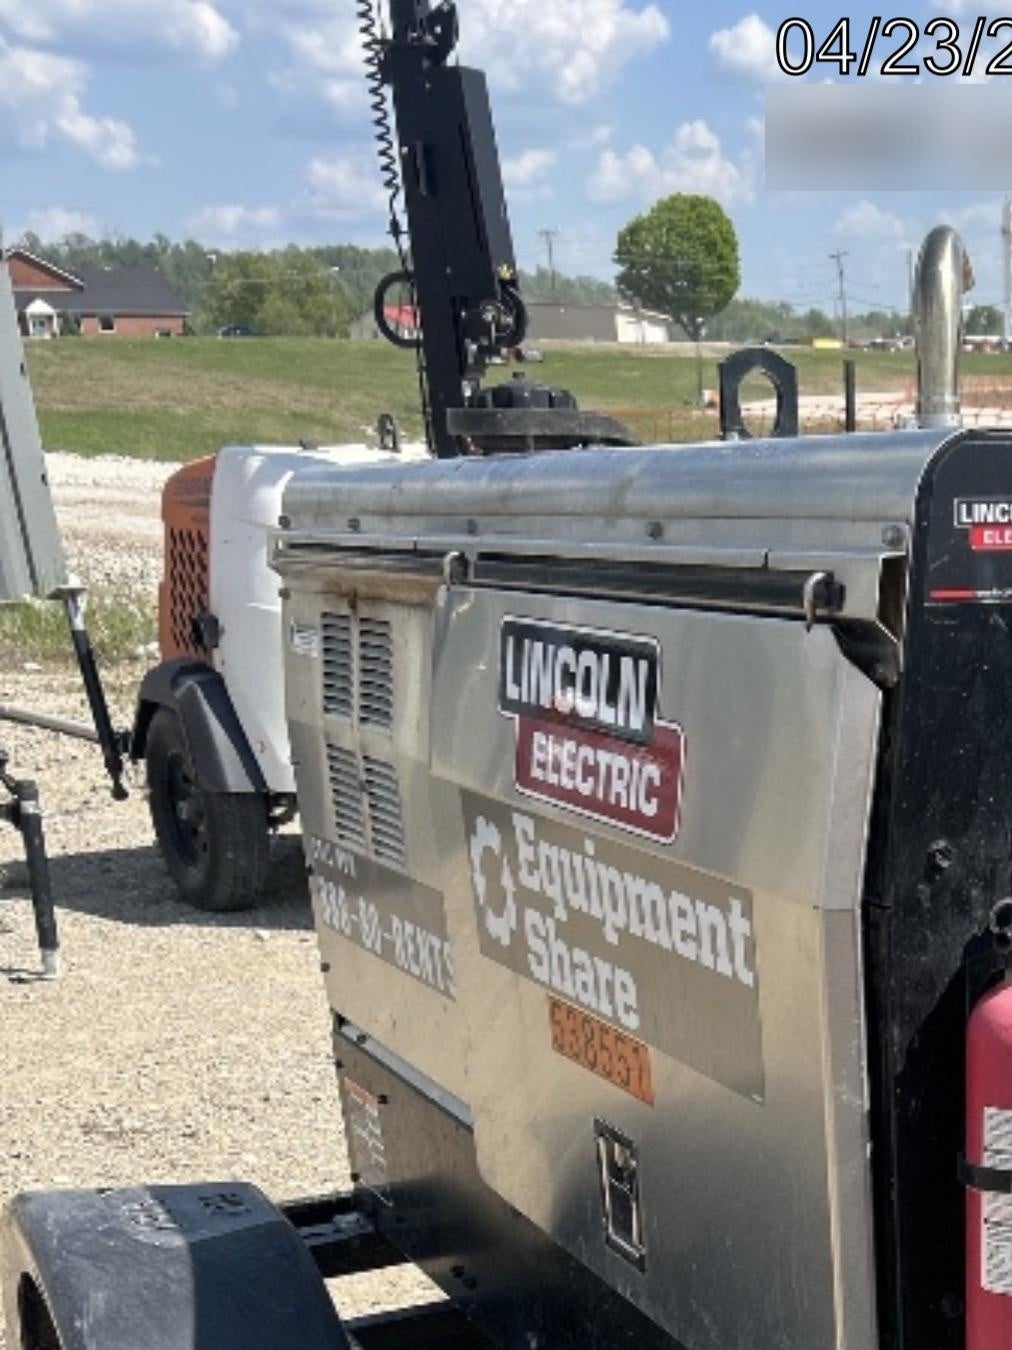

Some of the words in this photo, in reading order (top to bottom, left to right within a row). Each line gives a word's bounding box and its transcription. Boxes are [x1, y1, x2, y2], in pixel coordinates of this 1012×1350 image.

[505, 635, 649, 731] LINCOLN
[530, 731, 662, 818] ELECTRIC
[512, 812, 754, 988] Equipment
[524, 906, 641, 1031] Share
